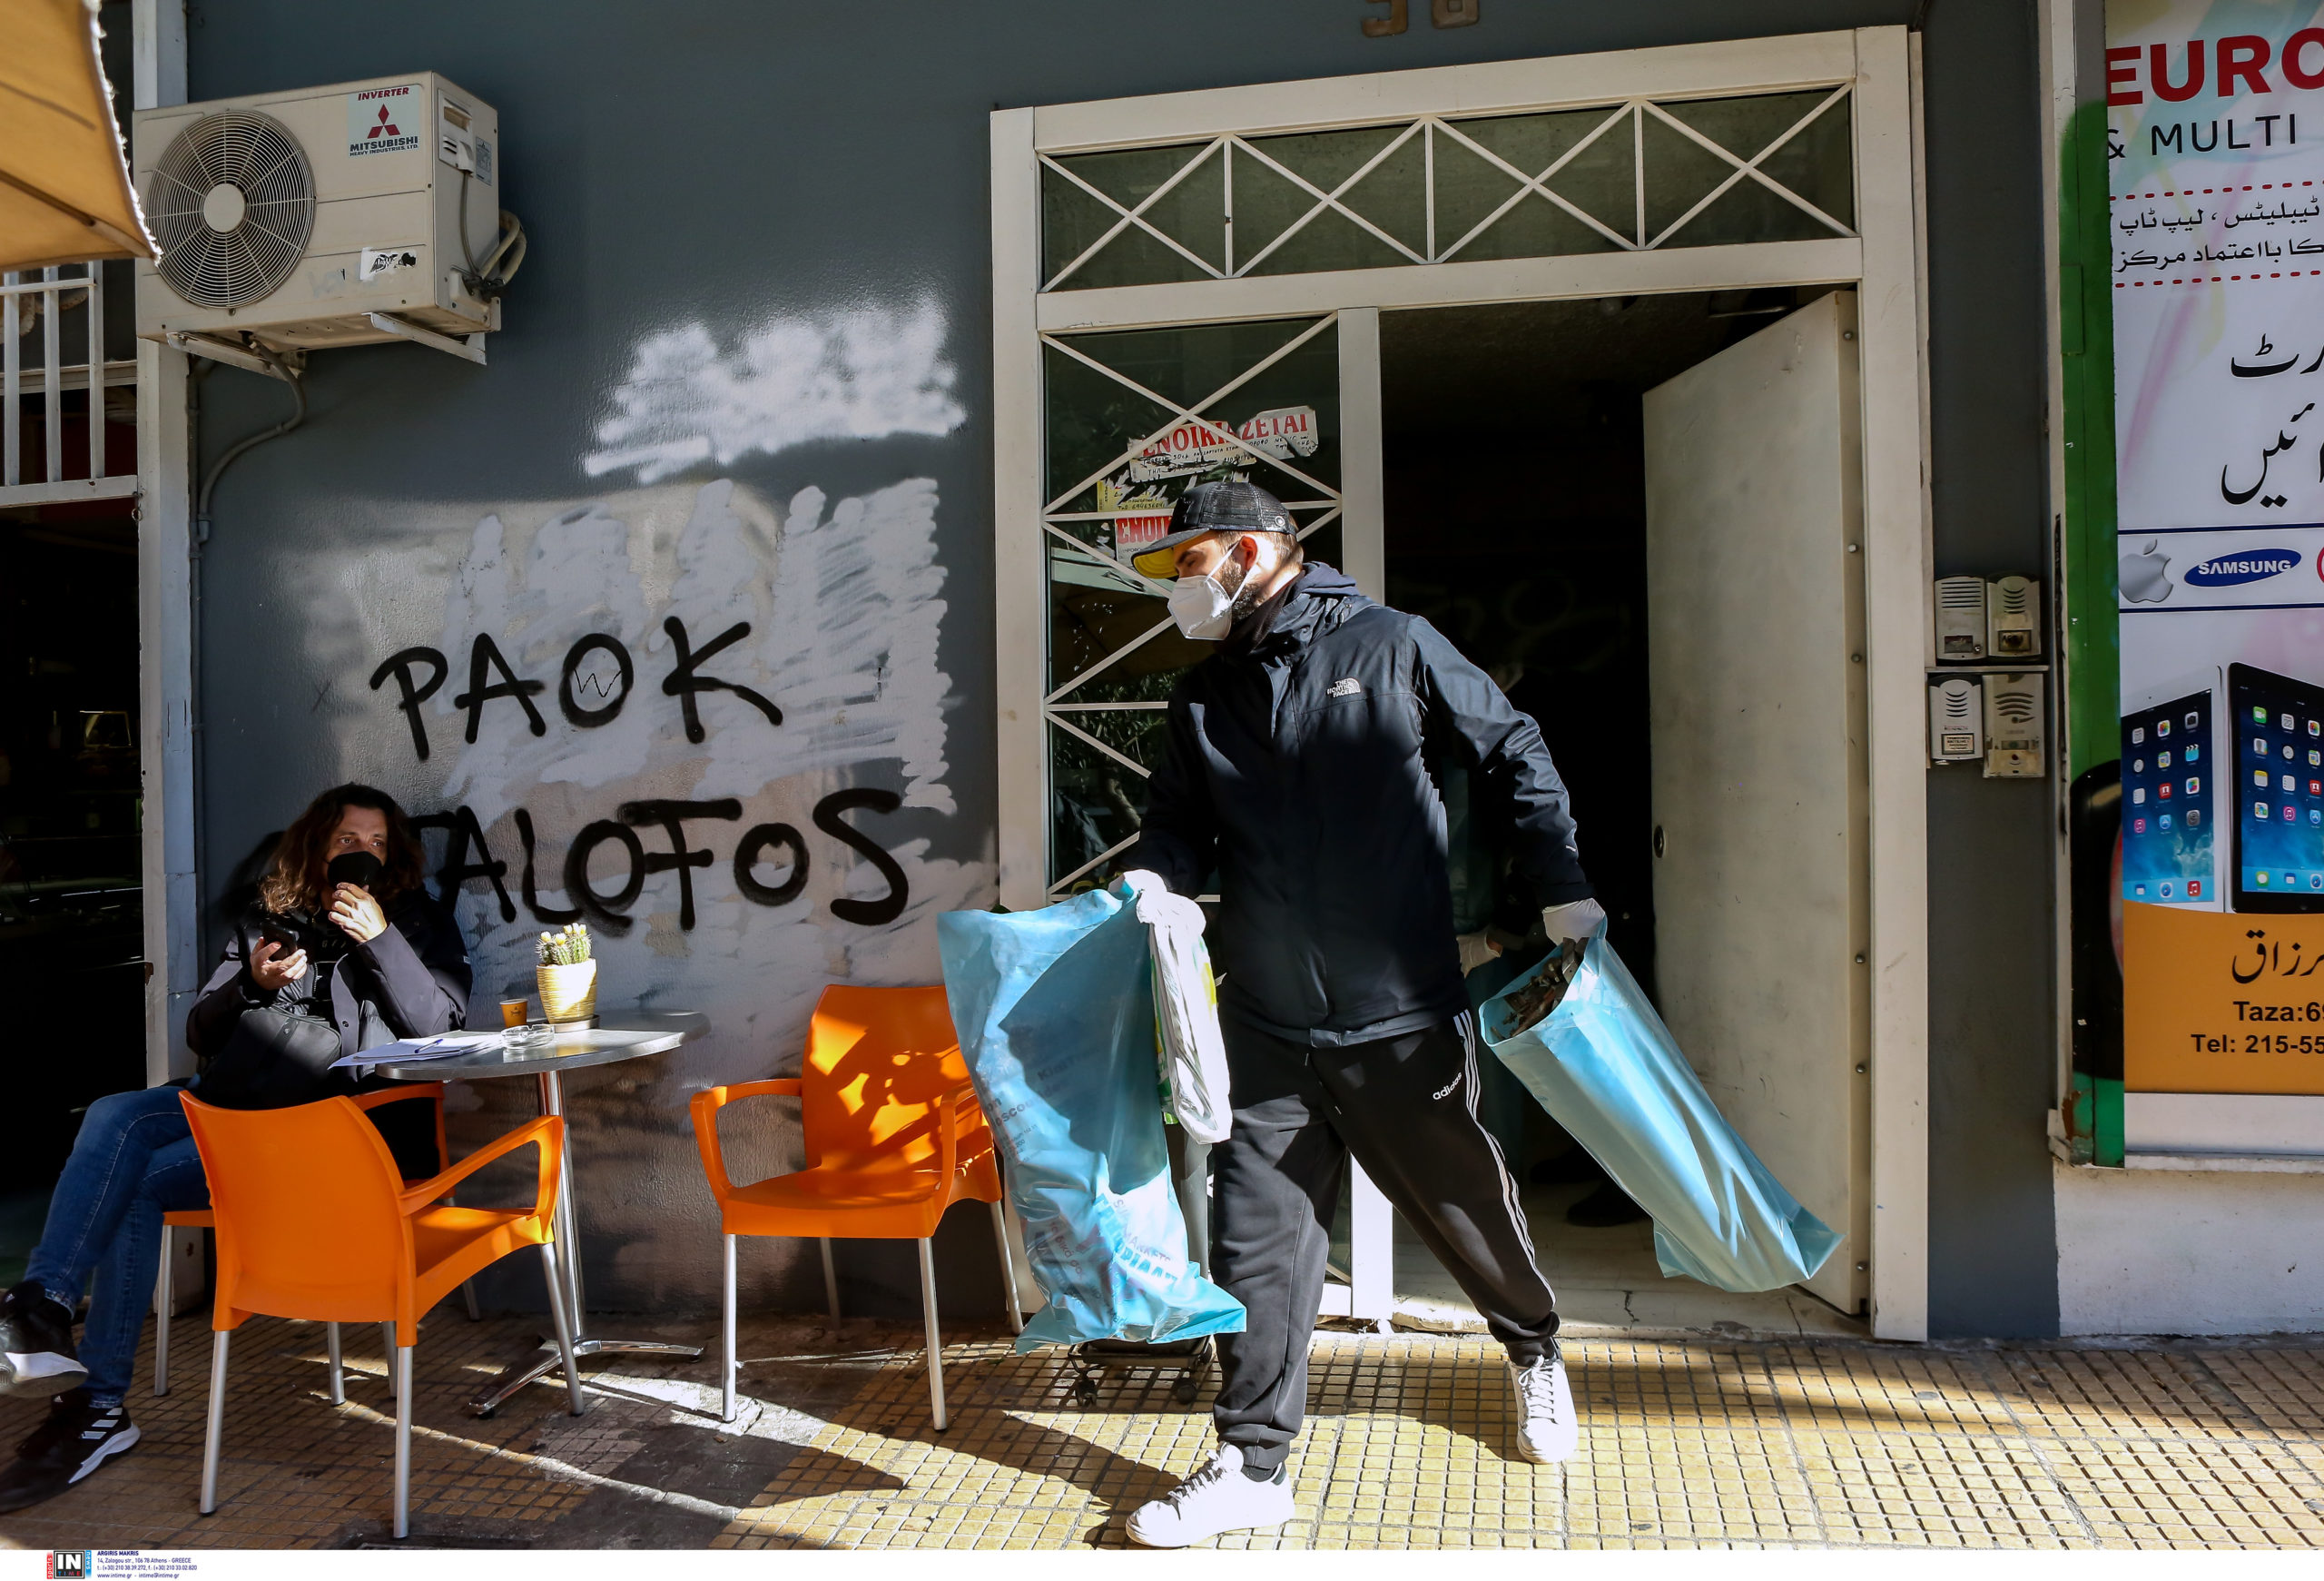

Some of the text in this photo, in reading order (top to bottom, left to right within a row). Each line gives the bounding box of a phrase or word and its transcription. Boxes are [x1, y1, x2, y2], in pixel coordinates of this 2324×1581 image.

[2105, 27, 2324, 107] EURO
[358, 87, 409, 101] INVERTER
[350, 135, 419, 152] MITSUBISHI
[2151, 114, 2296, 156] MULTI
[2198, 559, 2292, 577] SAMSUNG
[369, 616, 783, 761] PAOK
[2233, 1001, 2324, 1023] Taza:6
[2191, 1033, 2236, 1053] Tel:
[1433, 1072, 1462, 1100] adidas
